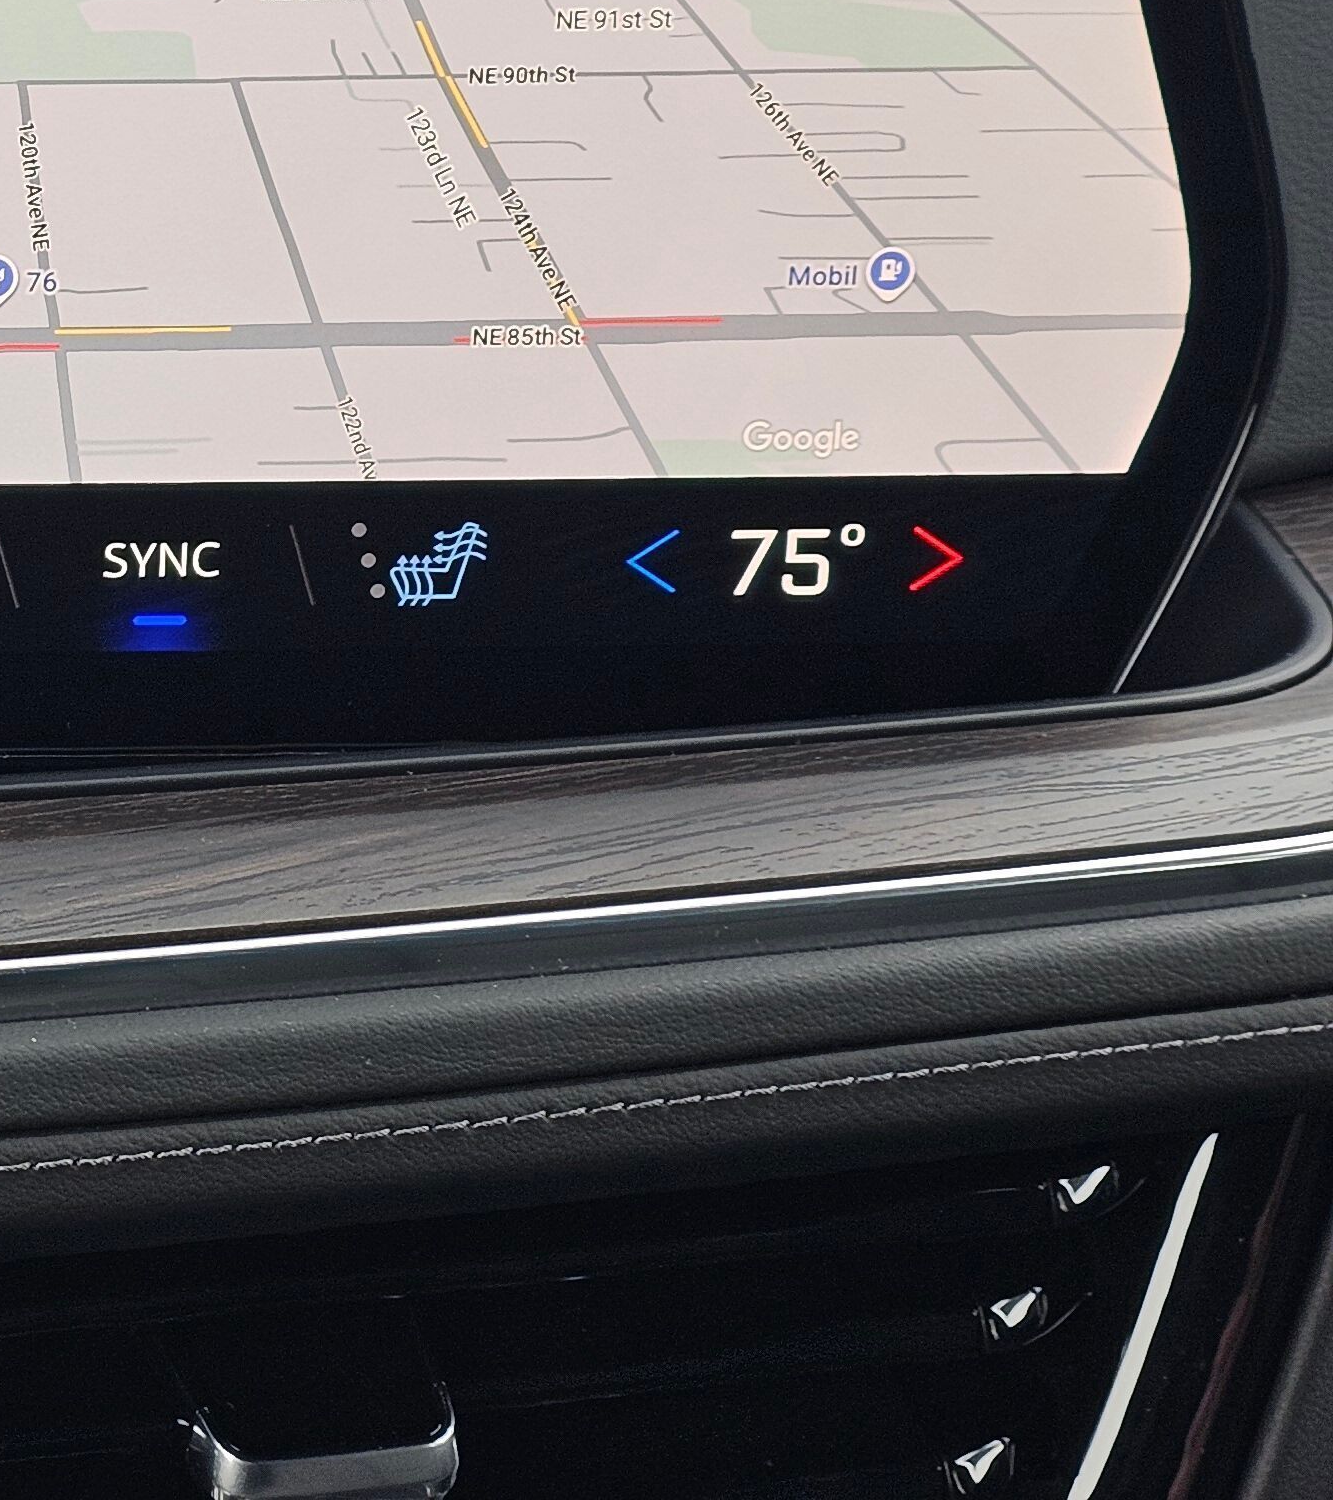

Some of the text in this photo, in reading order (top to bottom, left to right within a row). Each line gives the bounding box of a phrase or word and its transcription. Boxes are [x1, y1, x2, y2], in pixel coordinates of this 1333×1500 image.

[556, 10, 672, 28] NE 91st St
[470, 68, 575, 84] NE 90th St
[18, 123, 49, 251] 120th Ave NE
[28, 274, 56, 292] 76
[789, 267, 857, 286] Mobil
[473, 329, 581, 346] NE 85th St
[337, 396, 371, 455] 122nd
[743, 419, 859, 459] Google
[102, 541, 221, 579] SYNC
[731, 523, 866, 596] 75°
